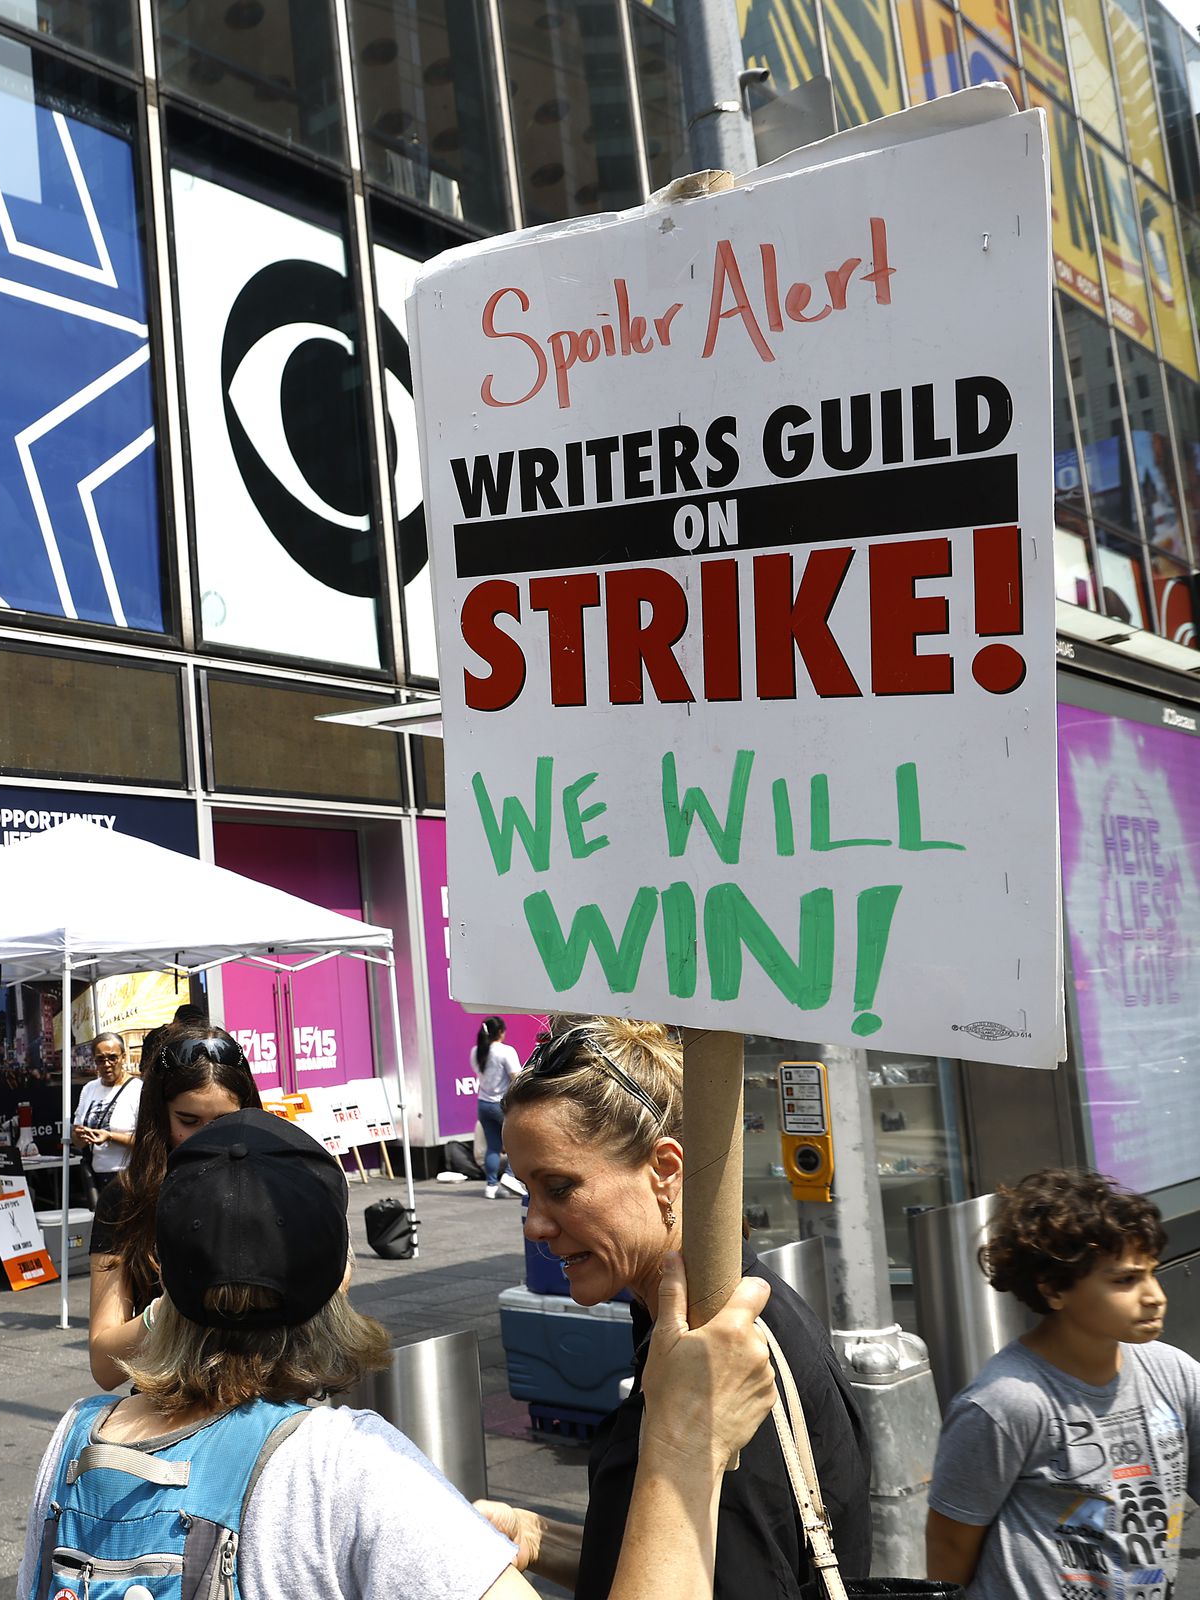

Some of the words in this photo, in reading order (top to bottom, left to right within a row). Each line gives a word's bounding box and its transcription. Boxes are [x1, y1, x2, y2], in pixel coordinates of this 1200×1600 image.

[480, 278, 683, 409] Spoiler
[702, 217, 896, 363] Alert
[450, 416, 739, 519] WRITERS
[762, 375, 1014, 478] GUILD
[672, 499, 739, 551] ON
[460, 524, 1027, 712] STRIKE!
[472, 755, 610, 876] WE
[661, 749, 966, 864] WILL
[1102, 815, 1165, 876] HERE
[523, 880, 902, 1037] WIN!
[1115, 880, 1166, 941] LIES
[1120, 944, 1182, 1007] LOVE
